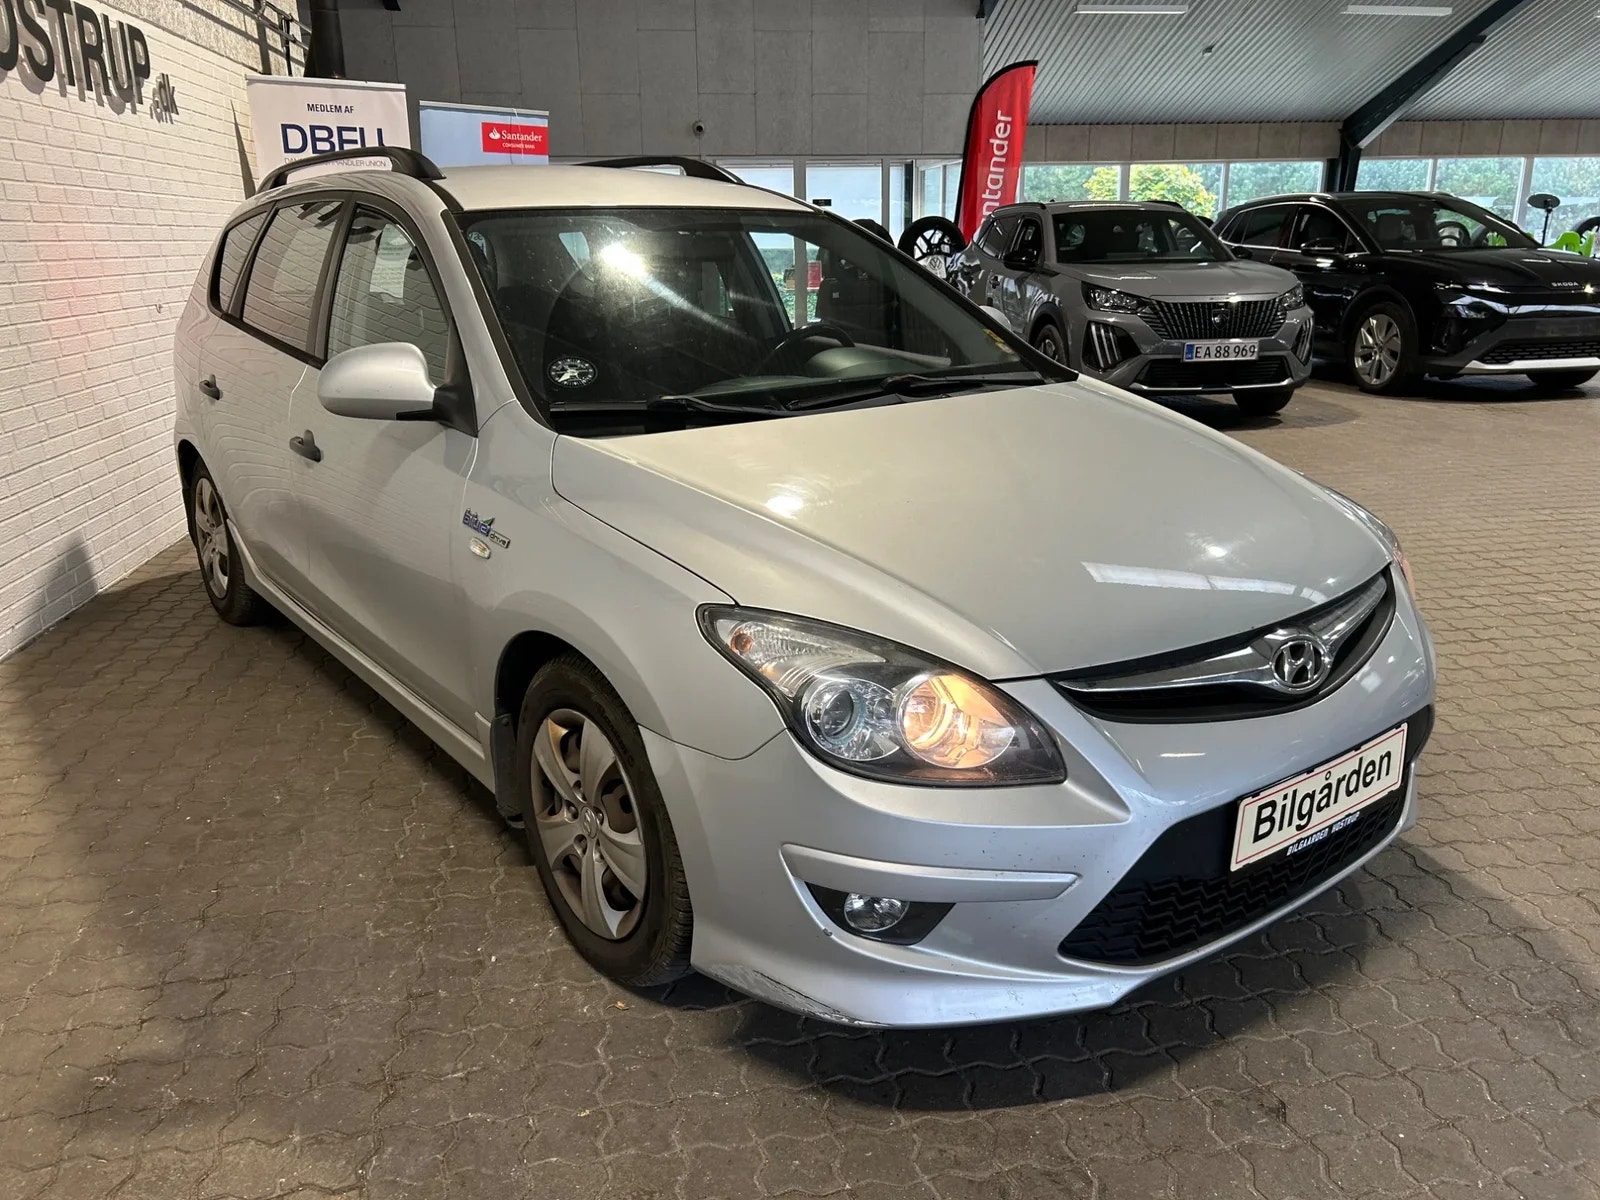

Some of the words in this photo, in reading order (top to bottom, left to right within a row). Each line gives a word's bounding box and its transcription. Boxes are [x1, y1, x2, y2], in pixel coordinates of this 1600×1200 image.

[307, 103, 342, 113] MEDLEM
[344, 105, 354, 114] AF
[501, 130, 543, 142] Santander
[980, 110, 1012, 225] ntander
[1195, 346, 1211, 359] EA
[1215, 345, 1230, 358] 88
[1233, 345, 1256, 358] 969
[1252, 750, 1392, 844] Bilgården
[1286, 827, 1330, 856] BILGAARDEN
